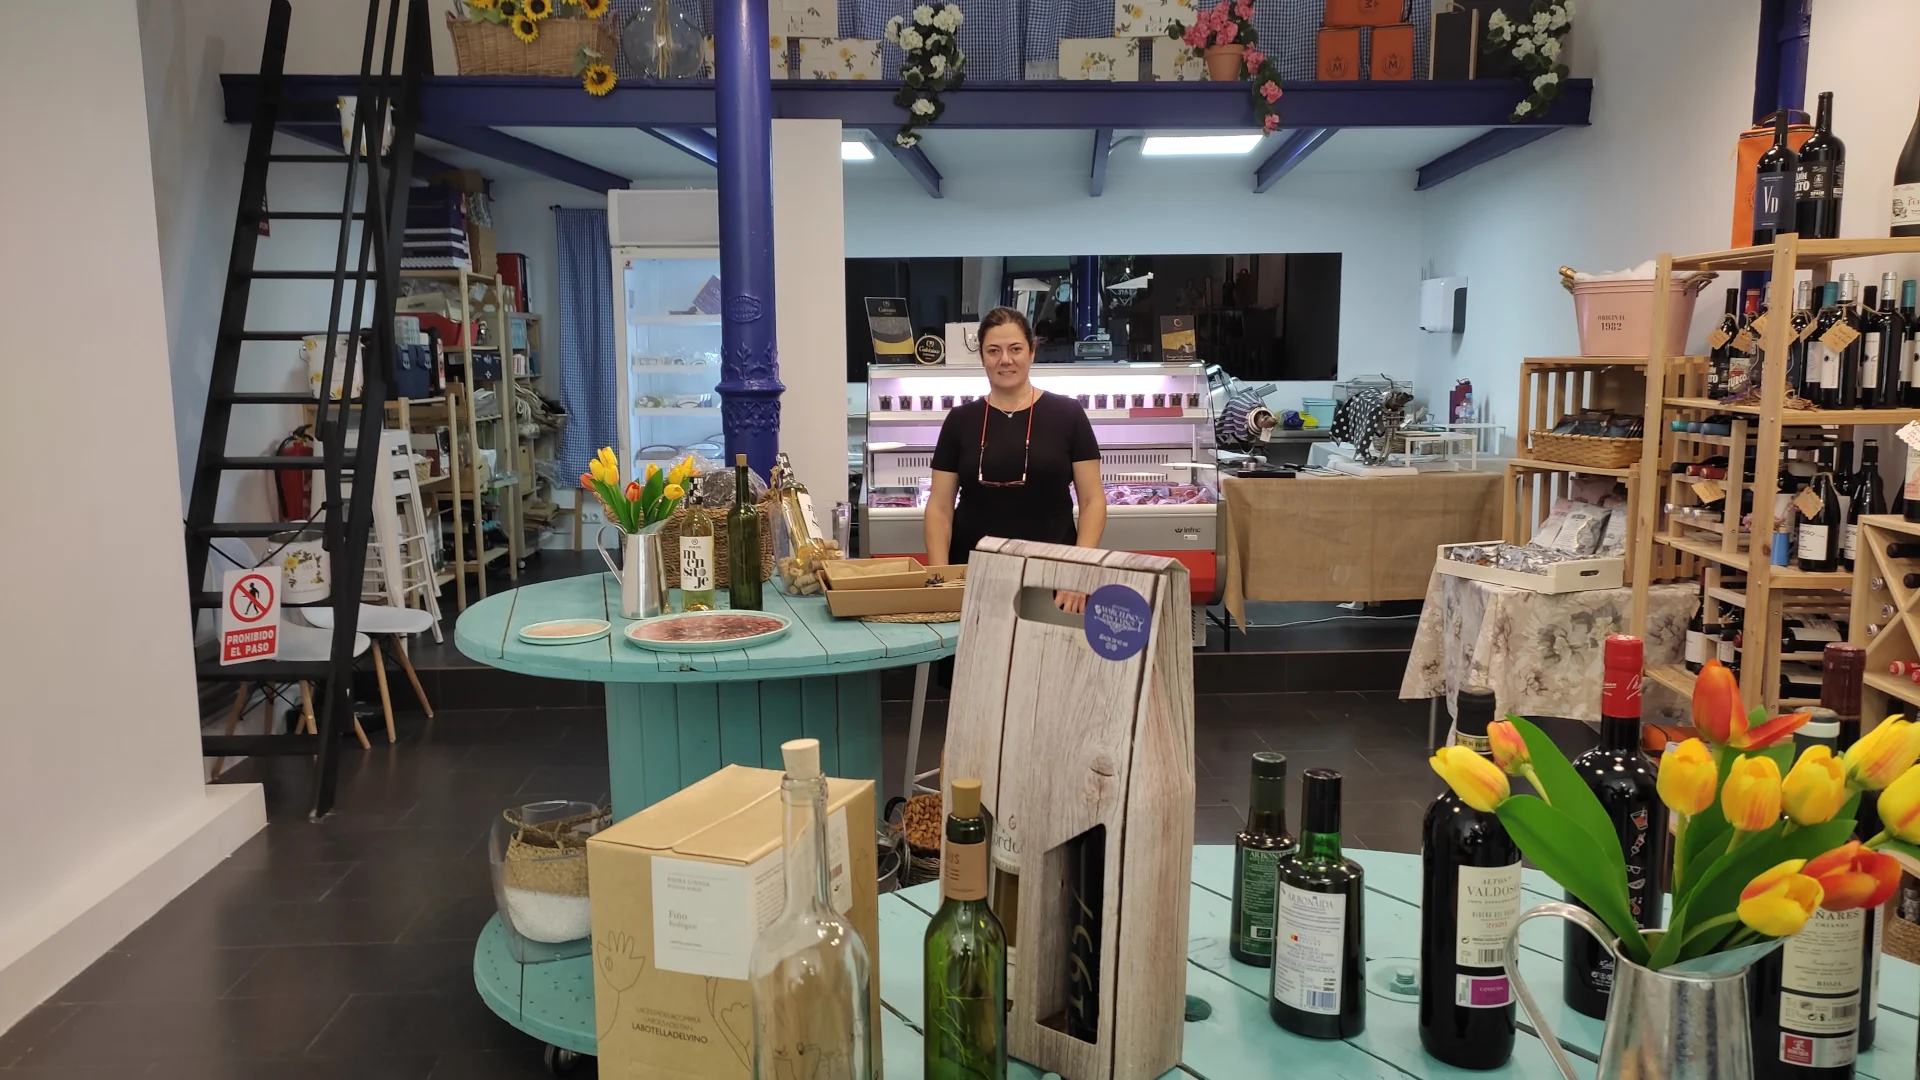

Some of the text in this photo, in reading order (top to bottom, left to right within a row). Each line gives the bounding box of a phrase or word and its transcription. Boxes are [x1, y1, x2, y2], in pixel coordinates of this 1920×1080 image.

[1601, 322, 1622, 331] 1982
[226, 630, 275, 646] PROHIBIDO
[230, 642, 270, 657] EL PASO
[669, 909, 688, 920] Fino
[1809, 909, 1860, 921] ÑARES
[1485, 920, 1508, 929] 2020
[631, 1022, 708, 1044] LABOTELLADELVINO
